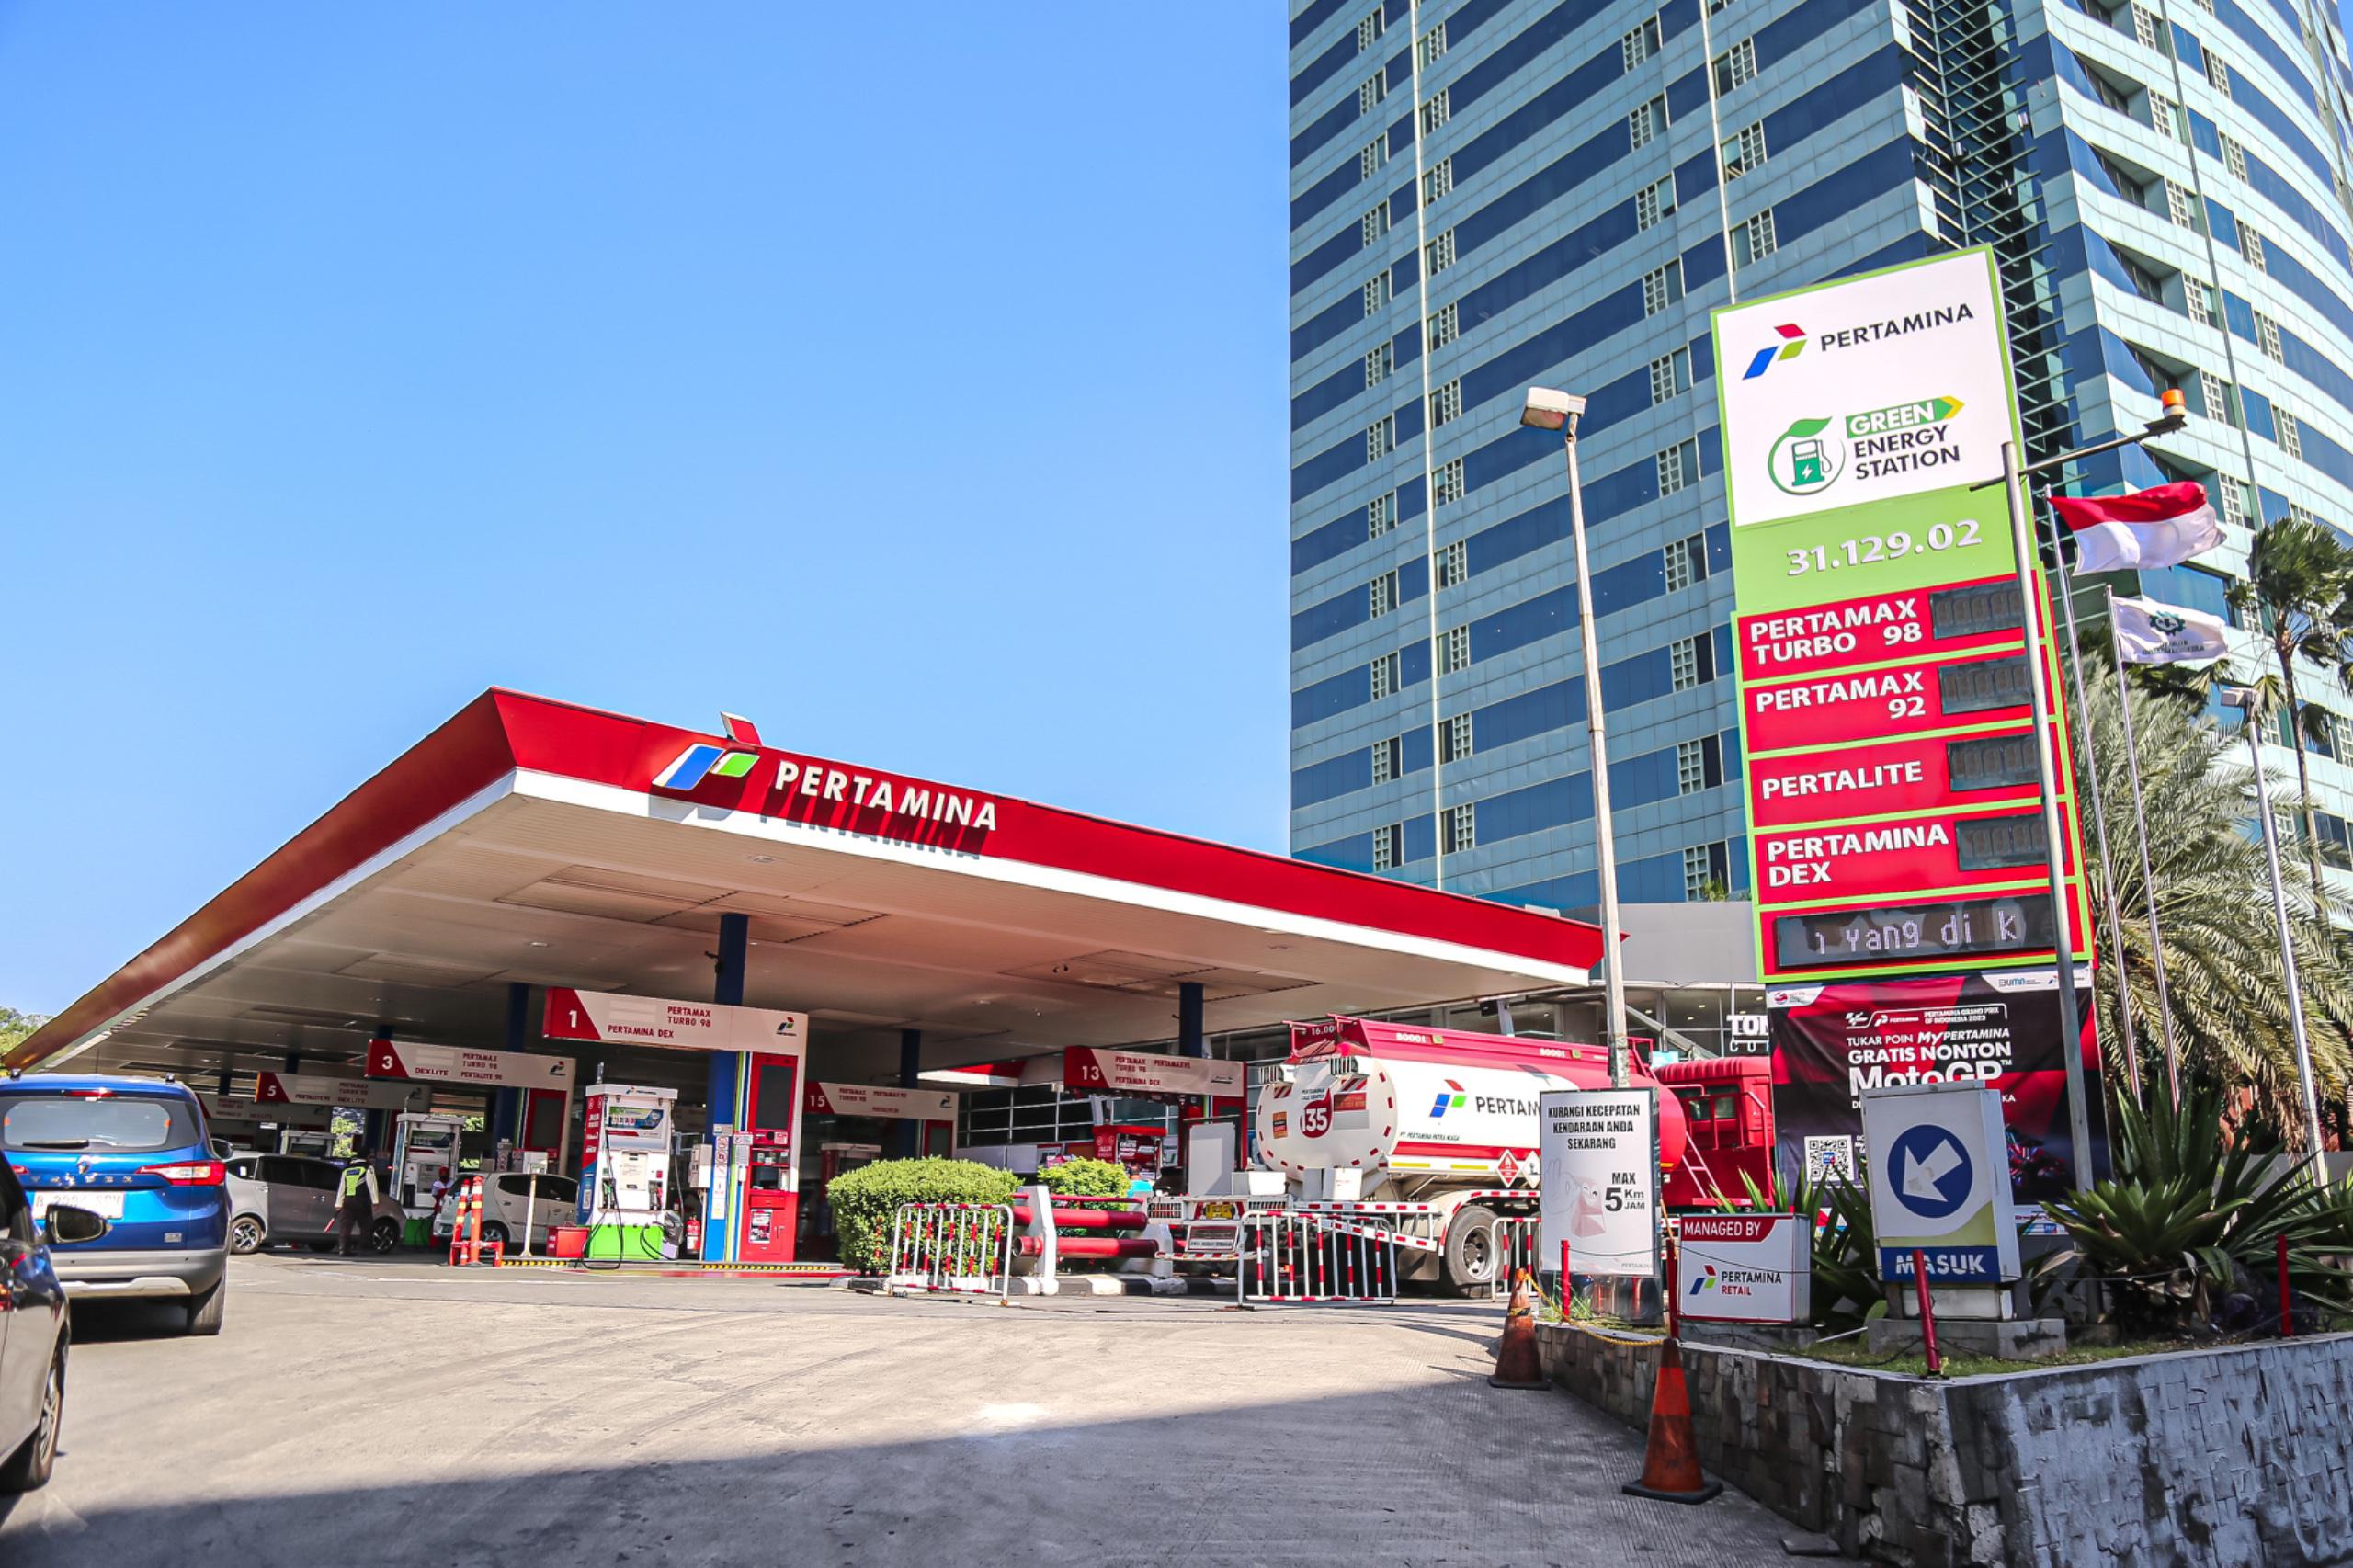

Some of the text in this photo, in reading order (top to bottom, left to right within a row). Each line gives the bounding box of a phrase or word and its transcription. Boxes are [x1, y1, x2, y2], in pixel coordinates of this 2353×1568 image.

[1820, 303, 1974, 351] PERTAMINA
[1849, 402, 1934, 436] GREEN
[1854, 425, 1949, 458] ENERGY
[1855, 445, 1961, 480] STATION
[1787, 518, 1982, 576] 31.129.02
[1750, 598, 1917, 642] PERTAMAX
[1753, 622, 1922, 665] TURBO 98
[1756, 671, 1925, 712] PERTAMAX
[1888, 699, 1926, 720] 92
[1762, 761, 1923, 800] PERTALITE
[775, 759, 996, 831] PERTAMINA
[1768, 824, 1949, 862] PERTAMINA
[1769, 861, 1832, 887] DEX
[1941, 914, 1972, 945] di
[569, 1010, 577, 1028] 1
[667, 1006, 711, 1017] PERTAMAX
[667, 1016, 711, 1028] TURBO 98
[608, 1025, 674, 1039] PERTAMINA DEX
[1847, 1036, 1882, 1047] TUKAR
[1885, 1034, 1914, 1044] POIN
[1848, 1041, 2012, 1064] GRATIS NONTON
[382, 1055, 393, 1070] 3
[415, 1067, 449, 1076] DEXLITE
[1082, 1065, 1100, 1081] 13
[267, 1085, 277, 1096] 5
[810, 1095, 825, 1108] 15
[1302, 1108, 1327, 1132] 135
[1548, 1104, 1640, 1118] KURANGI KECEPATAN
[1553, 1120, 1633, 1133] KENDARAAN ANDA
[1567, 1138, 1616, 1150] SEKARANG
[1612, 1172, 1636, 1184] MAX
[1605, 1187, 1622, 1211] 5
[1624, 1189, 1644, 1199] Km
[1624, 1201, 1644, 1210] JAM
[1684, 1221, 1761, 1236] MANAGED BY
[1895, 1254, 1985, 1275] MASUK
[1722, 1271, 1781, 1284] PERTAMINA
[1722, 1285, 1752, 1295] RETAIL
